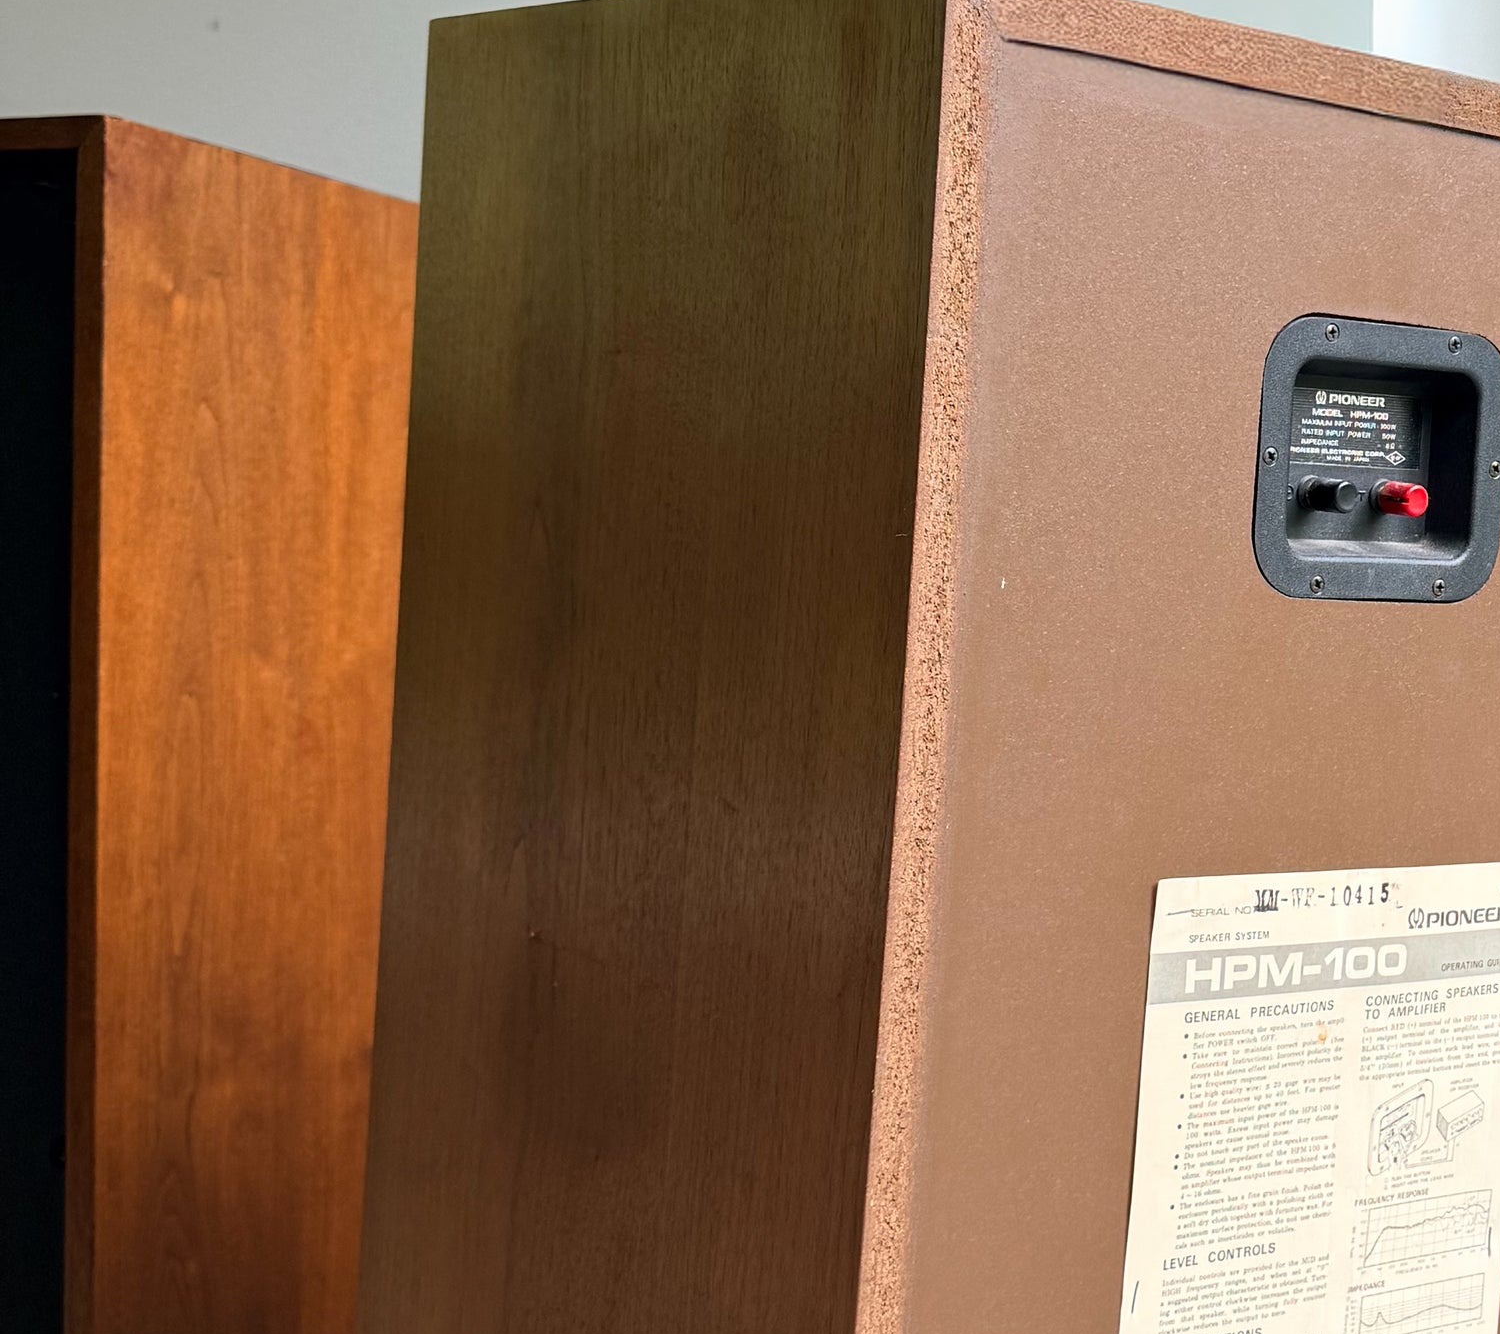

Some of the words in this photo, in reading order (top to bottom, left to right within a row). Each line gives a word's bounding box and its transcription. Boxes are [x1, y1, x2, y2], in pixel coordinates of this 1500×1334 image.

[1329, 394, 1385, 407] PIONEER
[1312, 408, 1343, 417] MODEL
[1350, 410, 1388, 420] HPM-100
[1302, 428, 1323, 436] RATED
[1190, 907, 1230, 917] SERIAL
[1188, 932, 1230, 943] SPEAKER
[1235, 930, 1269, 940] SYSTEM
[1185, 944, 1407, 994] HPM-100
[1441, 960, 1483, 971] OPERATING
[1365, 989, 1438, 1006] CONNECTING
[1446, 983, 1499, 998] SPEAKERS
[1184, 1008, 1240, 1024] GENERAL
[1250, 1000, 1334, 1018] PRECAUTIONS
[1364, 1008, 1380, 1020] TO
[1388, 1002, 1446, 1017] AMPLIFIER
[1162, 1253, 1199, 1271] LEVEL
[1207, 1241, 1276, 1263] CONTROLS
